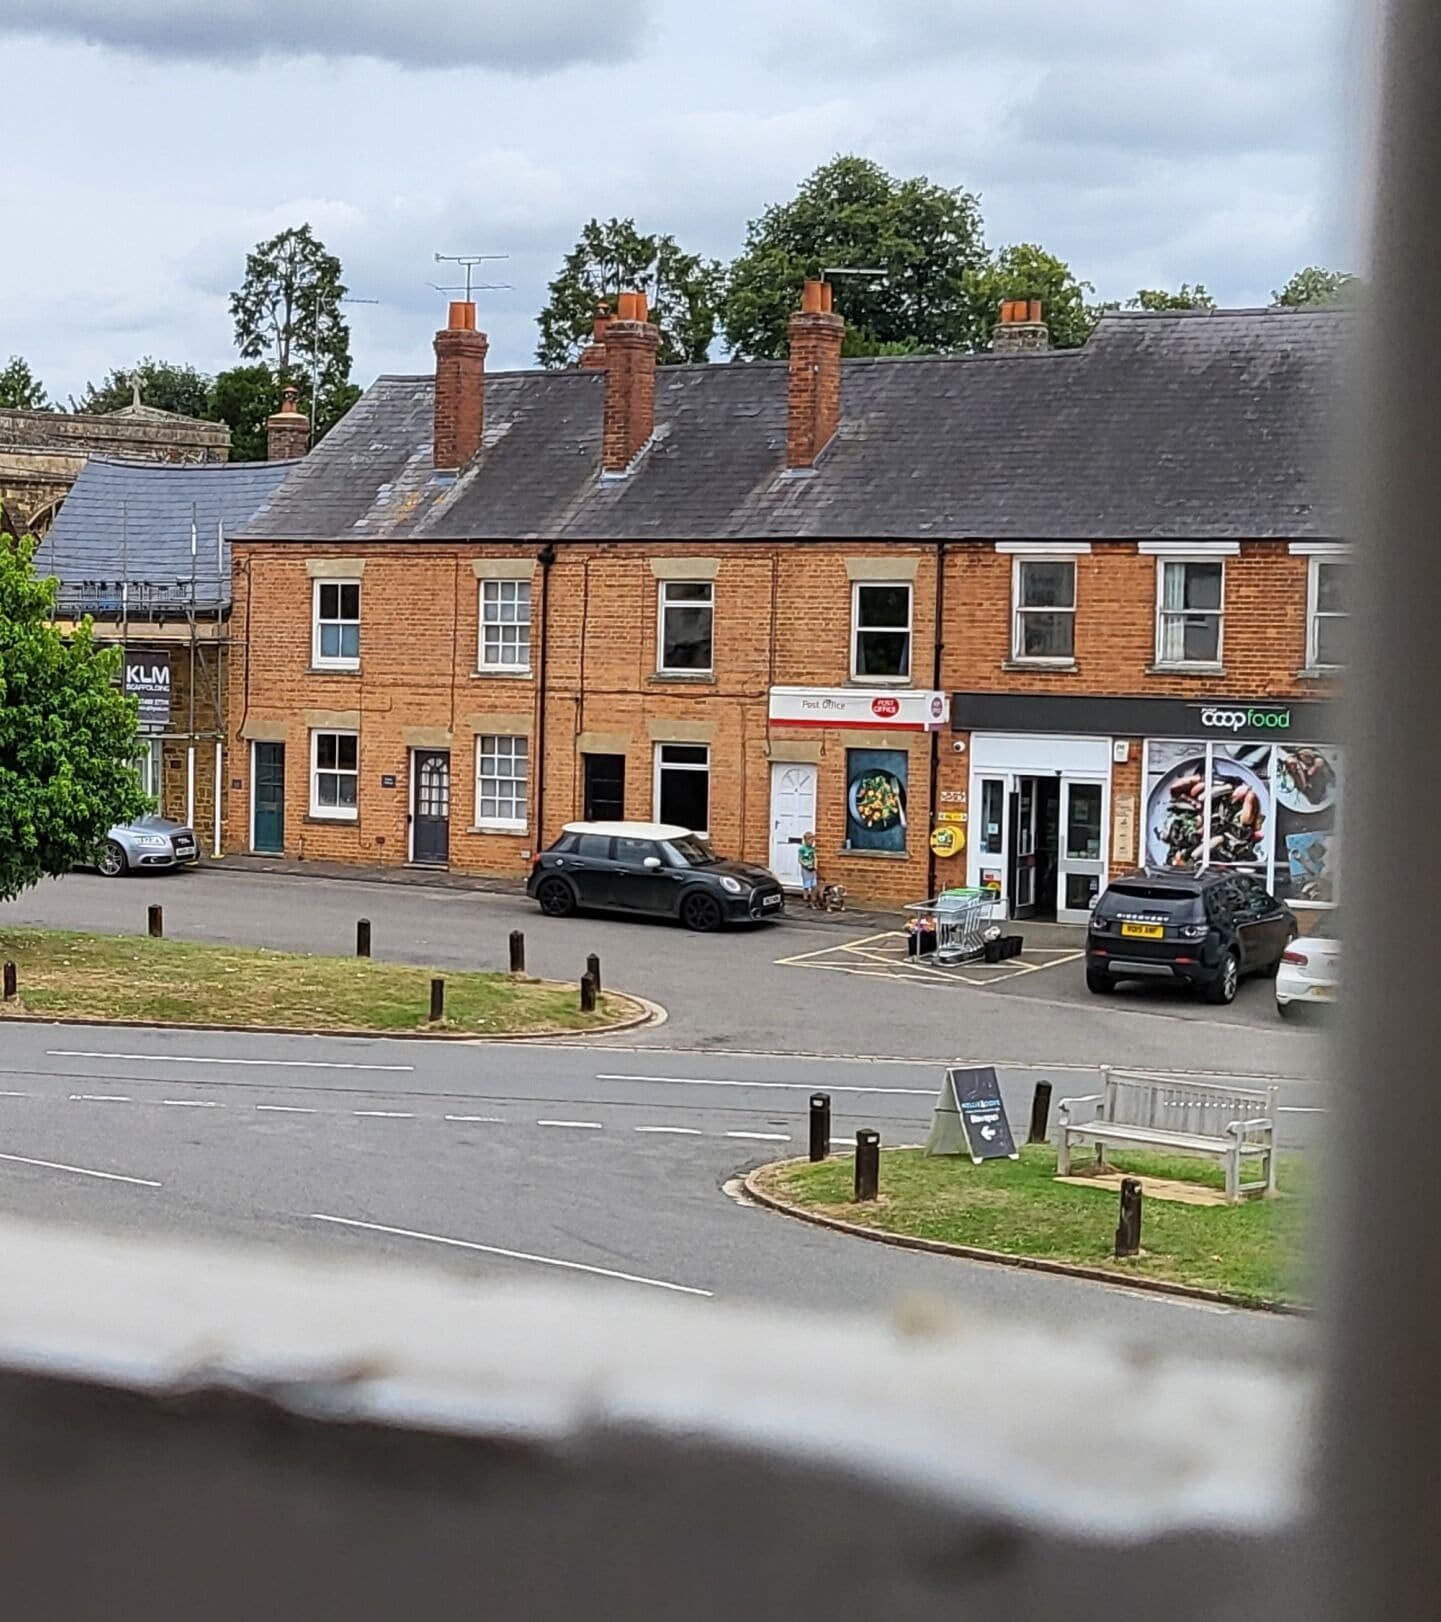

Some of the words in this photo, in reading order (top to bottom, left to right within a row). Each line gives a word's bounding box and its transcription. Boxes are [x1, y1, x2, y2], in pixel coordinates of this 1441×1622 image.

[126, 665, 170, 685] KLM
[802, 700, 819, 709] Post
[822, 699, 846, 710] Office
[873, 705, 897, 713] OFFICE
